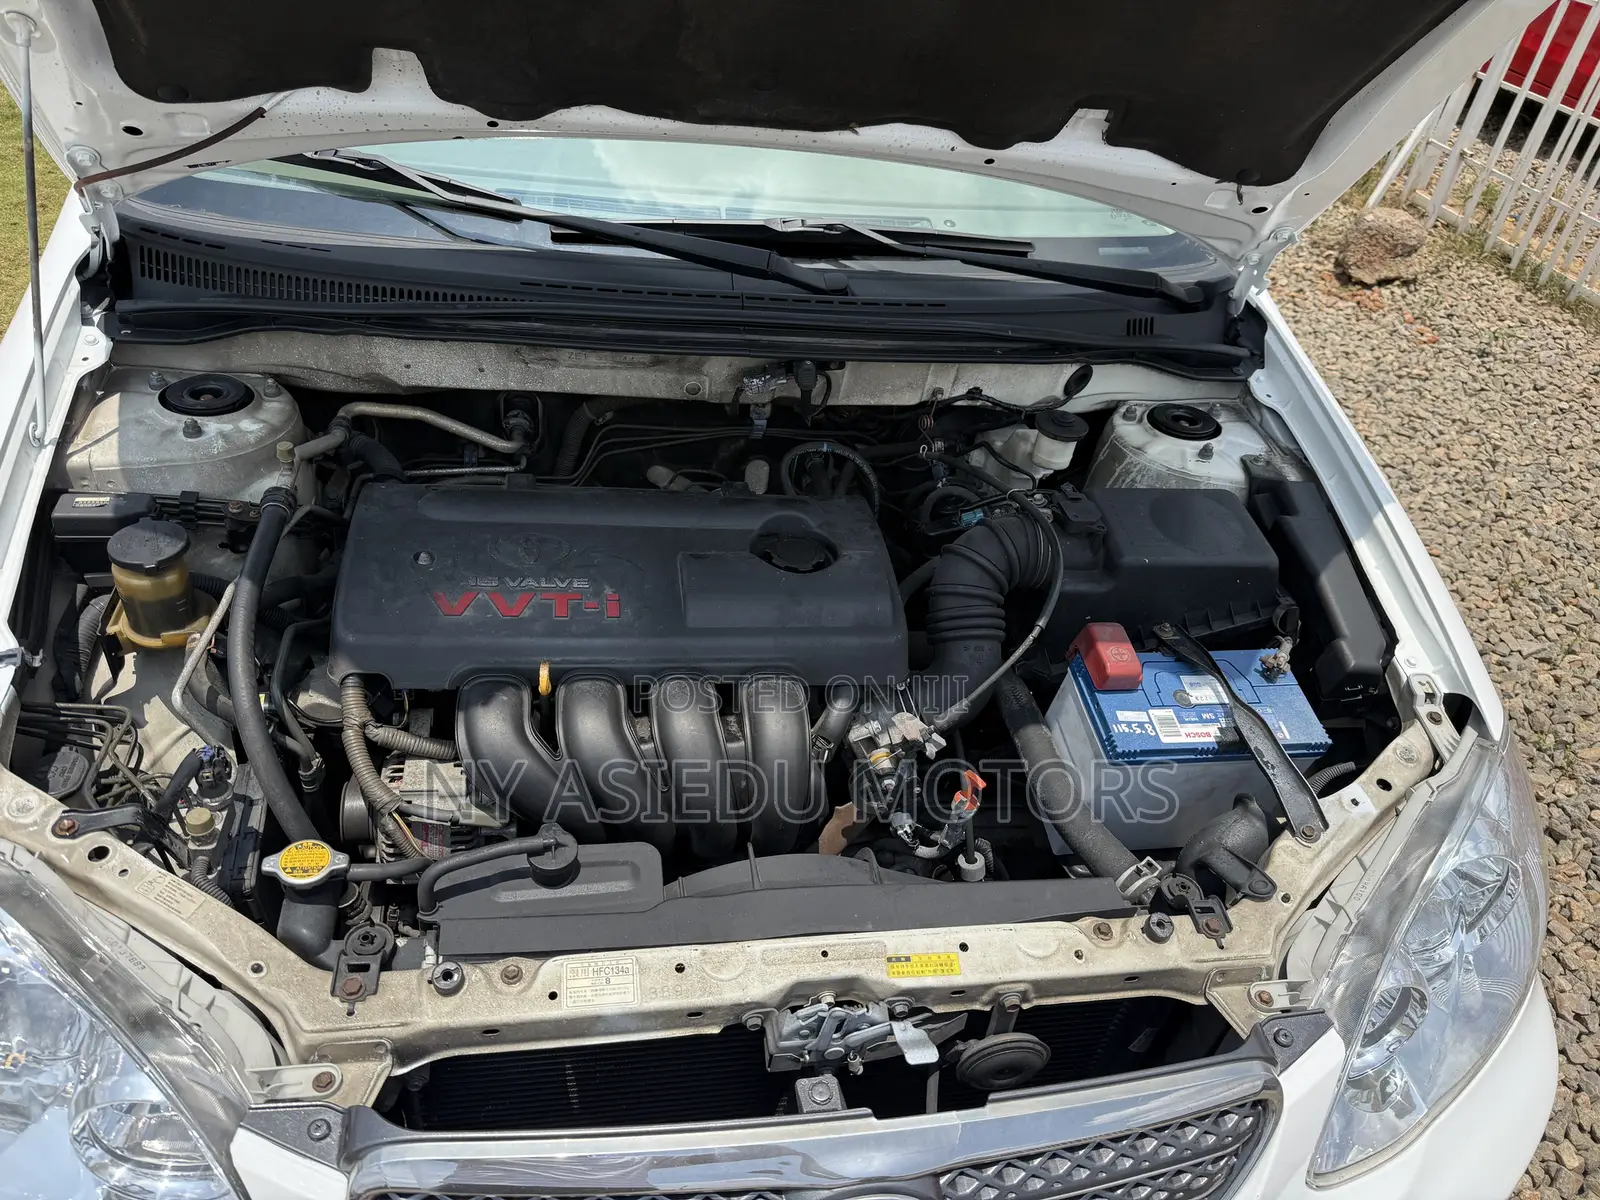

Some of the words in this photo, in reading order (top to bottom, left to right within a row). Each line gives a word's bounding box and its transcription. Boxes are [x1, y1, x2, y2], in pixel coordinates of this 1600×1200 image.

[504, 576, 591, 588] VALVE
[431, 591, 621, 619] VVT-i
[1185, 731, 1211, 739] BOSCH
[592, 965, 630, 976] HFC134a
[604, 977, 612, 985] 8
